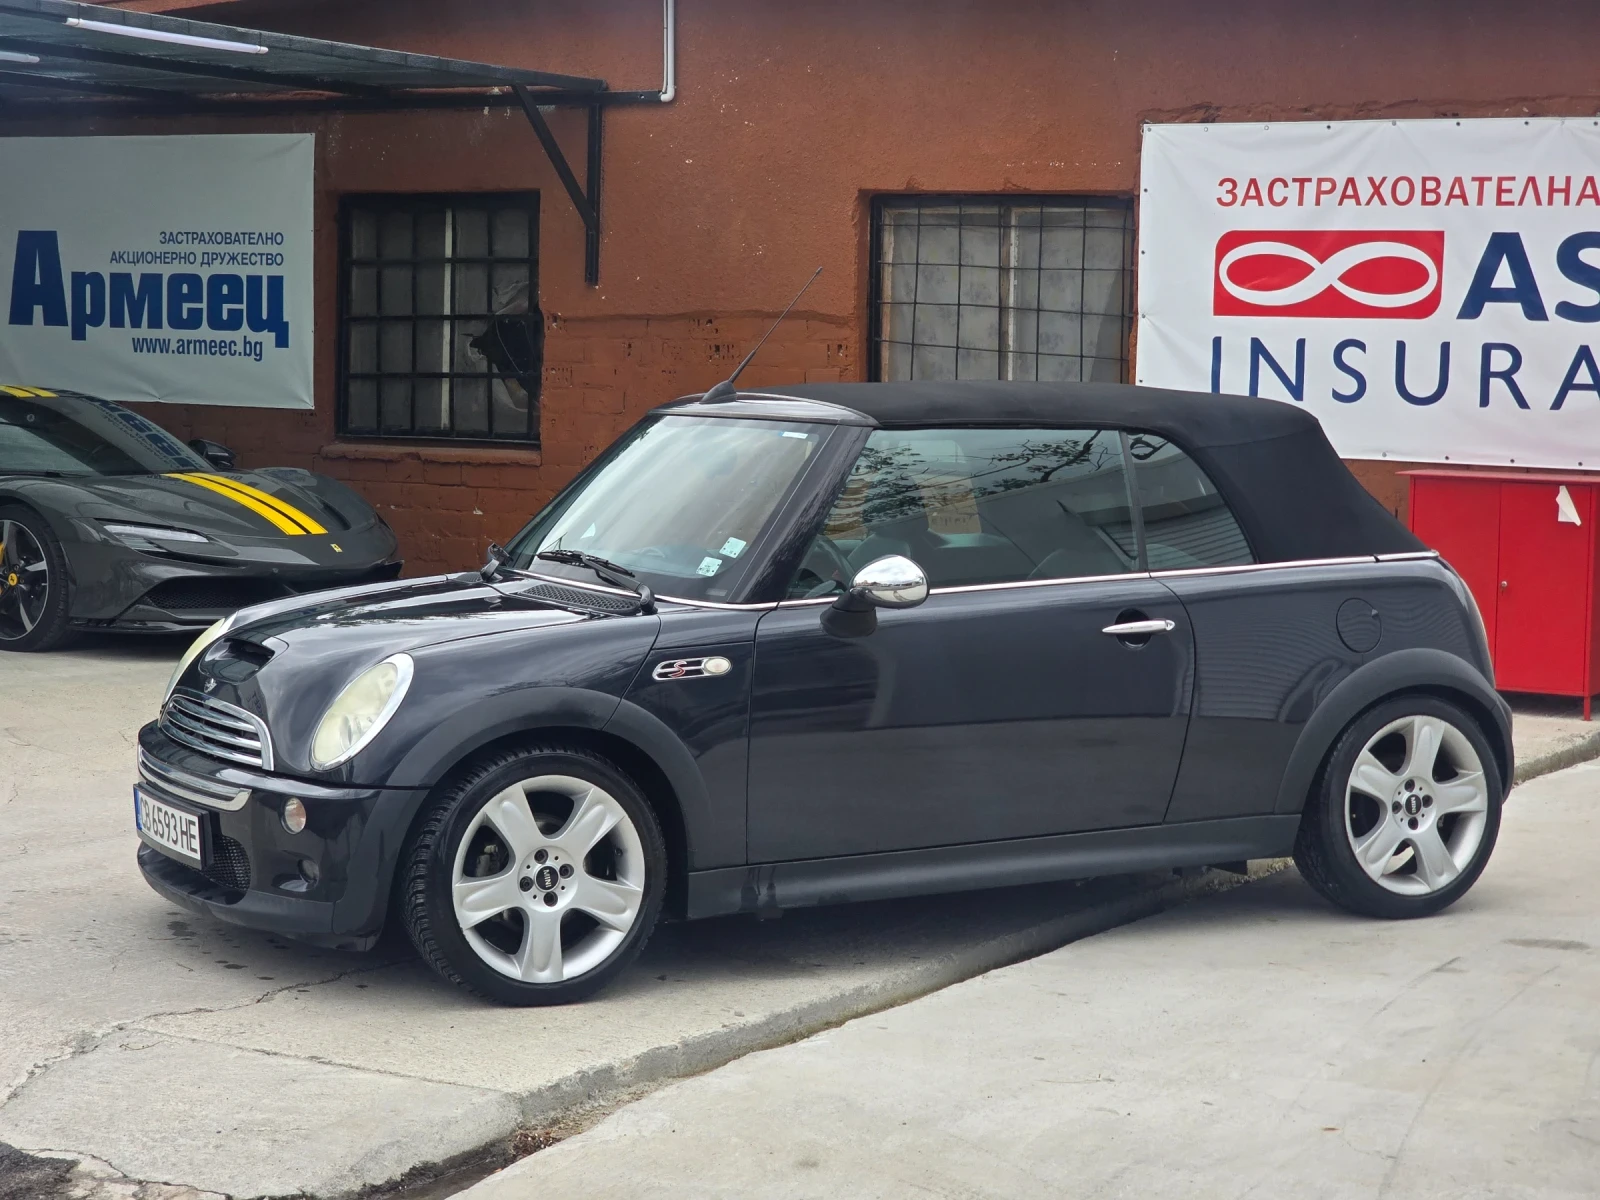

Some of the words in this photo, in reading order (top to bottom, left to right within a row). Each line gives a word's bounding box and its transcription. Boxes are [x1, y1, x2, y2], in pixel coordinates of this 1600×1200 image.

[1216, 175, 1600, 207] ЗАСТРАХОВАТЕЛНА
[159, 231, 284, 245] ЗАСТРАХОВАТЕЛНО
[110, 251, 197, 266] АКЦИОНЕРНО
[200, 252, 284, 267] ДРУЖЕСТВО
[9, 230, 289, 349] Армеец
[132, 336, 263, 361] www.armeec.bg
[152, 804, 178, 845] 6593
[179, 815, 198, 854] HE
[543, 869, 552, 888] MINI
